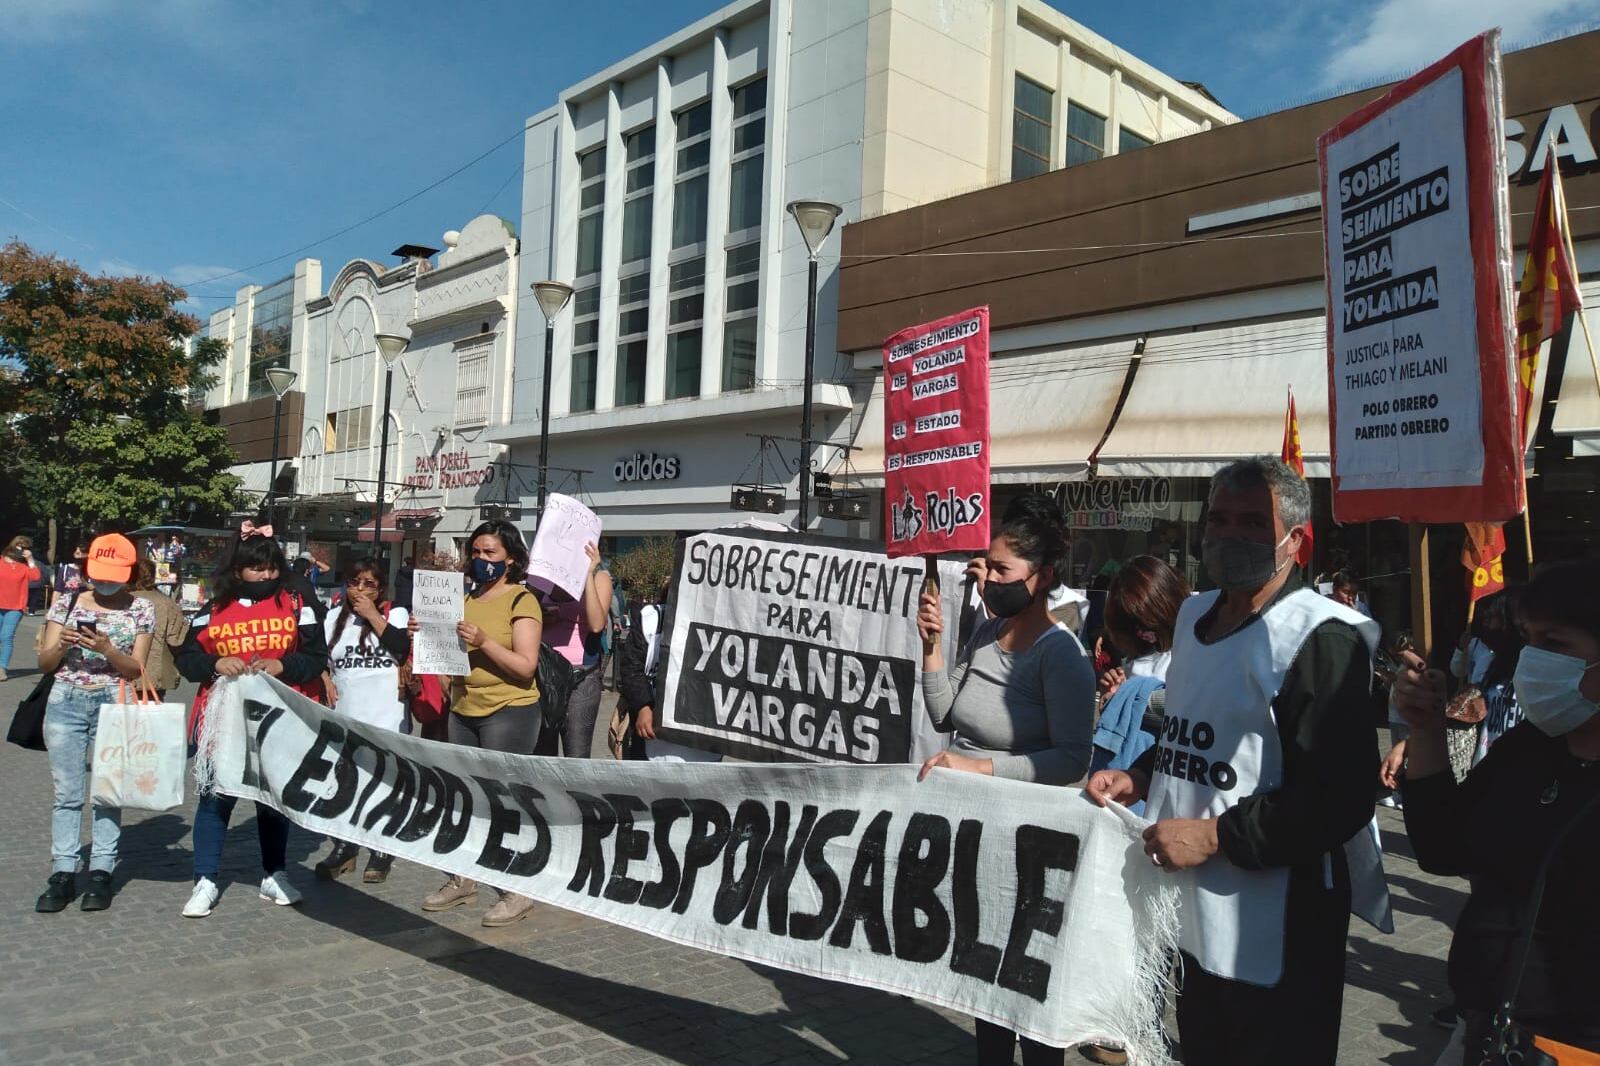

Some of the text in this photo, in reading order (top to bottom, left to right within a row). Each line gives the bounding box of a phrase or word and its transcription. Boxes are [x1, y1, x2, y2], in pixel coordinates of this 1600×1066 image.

[1340, 151, 1399, 202] SOBRE
[1342, 176, 1448, 244] SEIMIENTO
[1344, 245, 1393, 285] PARA
[1344, 275, 1438, 325] YOLANDA
[891, 321, 978, 361] SOBRESEIMIENTO
[1345, 333, 1424, 366] JUSTICIA PARA
[894, 349, 963, 388] DE YOLANDA
[1345, 356, 1448, 390] THIAGO Y MELANI
[914, 376, 957, 397] VARGAS
[1363, 394, 1439, 417] POLO OBRERO
[895, 414, 959, 436] EL ESTADO
[1355, 418, 1450, 440] PARTIDO OBRERO
[613, 452, 678, 482] adidas
[889, 444, 980, 469] ES RESPONSABLE
[439, 465, 495, 490] FRANCISCO
[95, 546, 116, 560] pdt
[415, 573, 449, 589] JUSTICIA
[419, 591, 452, 607] YOLANDA
[208, 616, 295, 641] PARTIDO
[766, 602, 832, 641] PARA
[335, 657, 393, 669] OBRERO
[693, 628, 902, 716] YOLANDA
[710, 682, 881, 763] VARGAS
[1160, 715, 1215, 751] POLO
[281, 720, 474, 855] ESTADO
[470, 774, 553, 877] ES
[565, 789, 1080, 1002] RESPONSABLE
